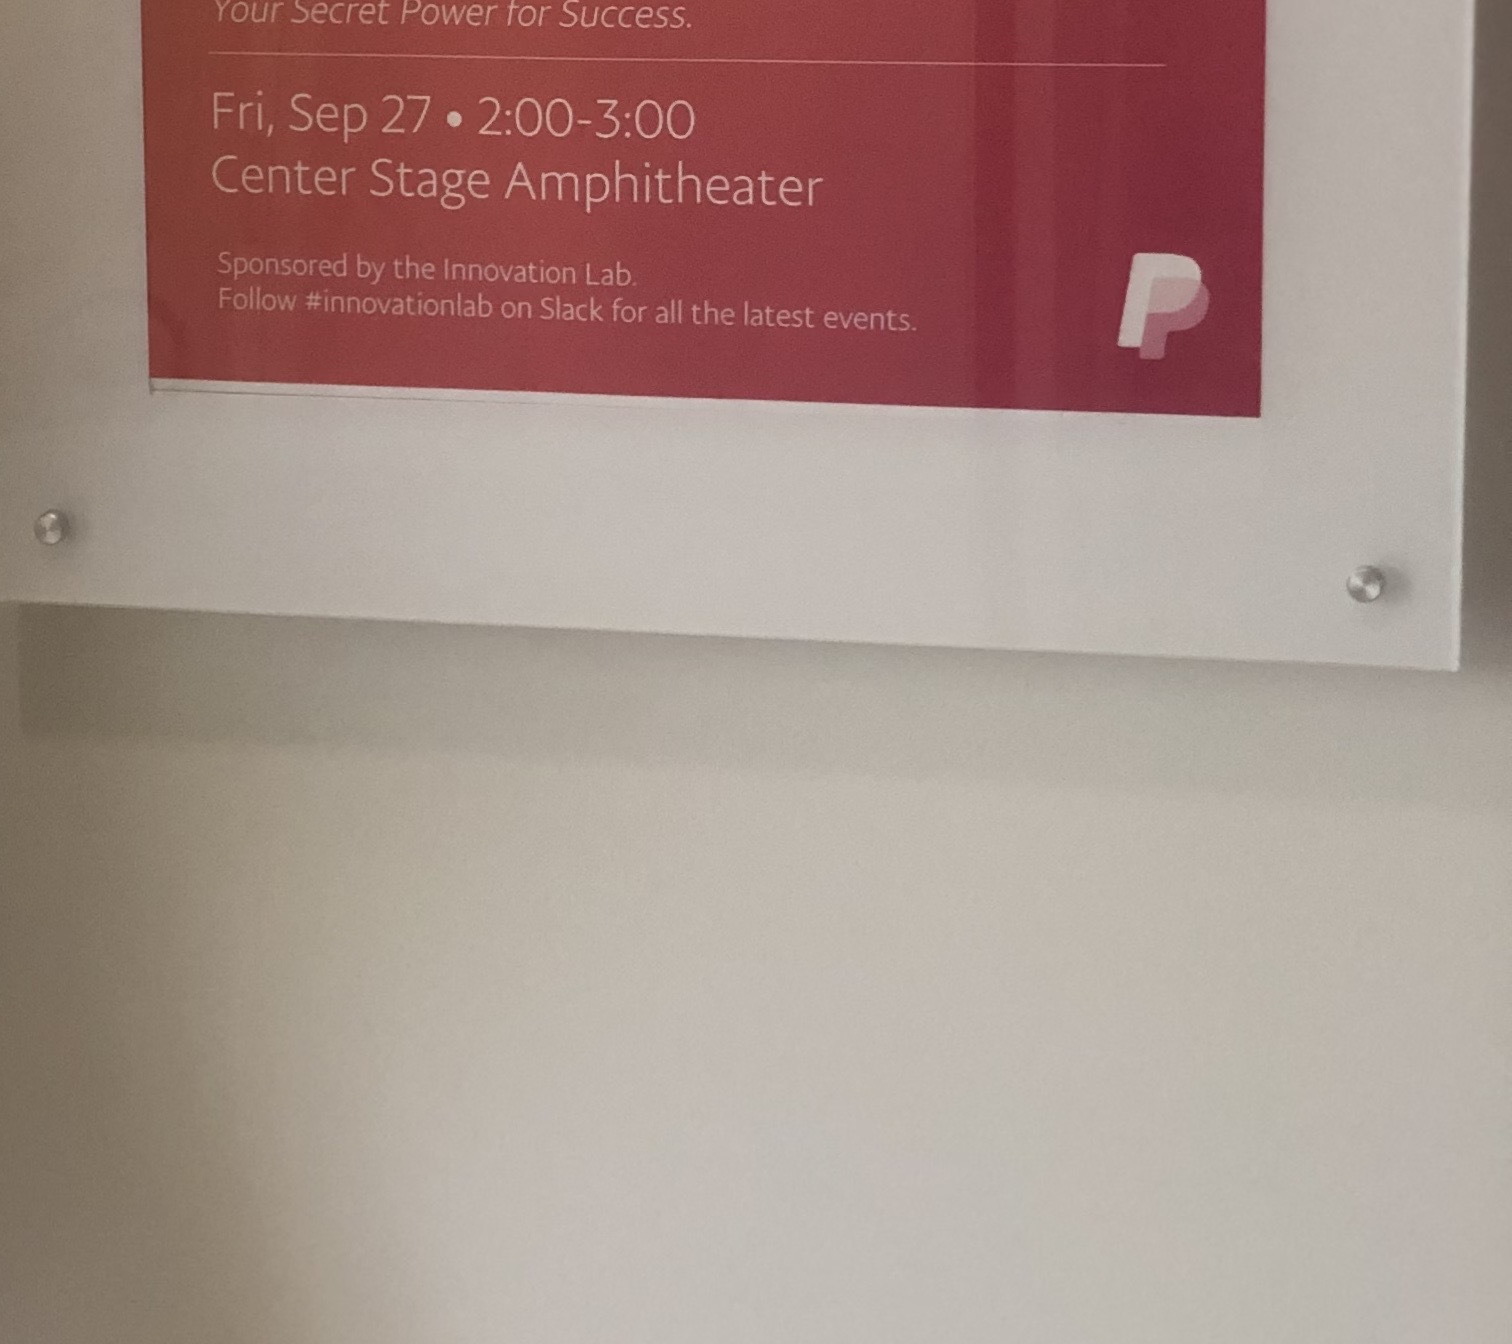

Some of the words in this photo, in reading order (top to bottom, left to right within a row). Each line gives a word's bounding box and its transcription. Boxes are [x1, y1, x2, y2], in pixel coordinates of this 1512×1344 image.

[213, 90, 273, 137] Fri,
[289, 93, 368, 143] Sep
[382, 94, 431, 133] 27
[479, 96, 695, 139] 2:00-3:00
[212, 155, 356, 196] Center
[370, 158, 490, 210] Stage
[505, 160, 823, 213] Amphitheater
[218, 251, 348, 280] Sponsored
[356, 253, 385, 285] by
[393, 255, 436, 280] the
[444, 258, 577, 284] Innovation
[586, 261, 636, 288] Lab.
[219, 286, 297, 311] Follow
[305, 289, 493, 319] #innovationlab
[501, 301, 532, 319] on
[540, 296, 603, 322] Slack
[612, 297, 647, 323] for
[655, 299, 682, 323] all
[691, 300, 735, 326] the
[744, 301, 814, 328] latest
[823, 307, 917, 332] events.
